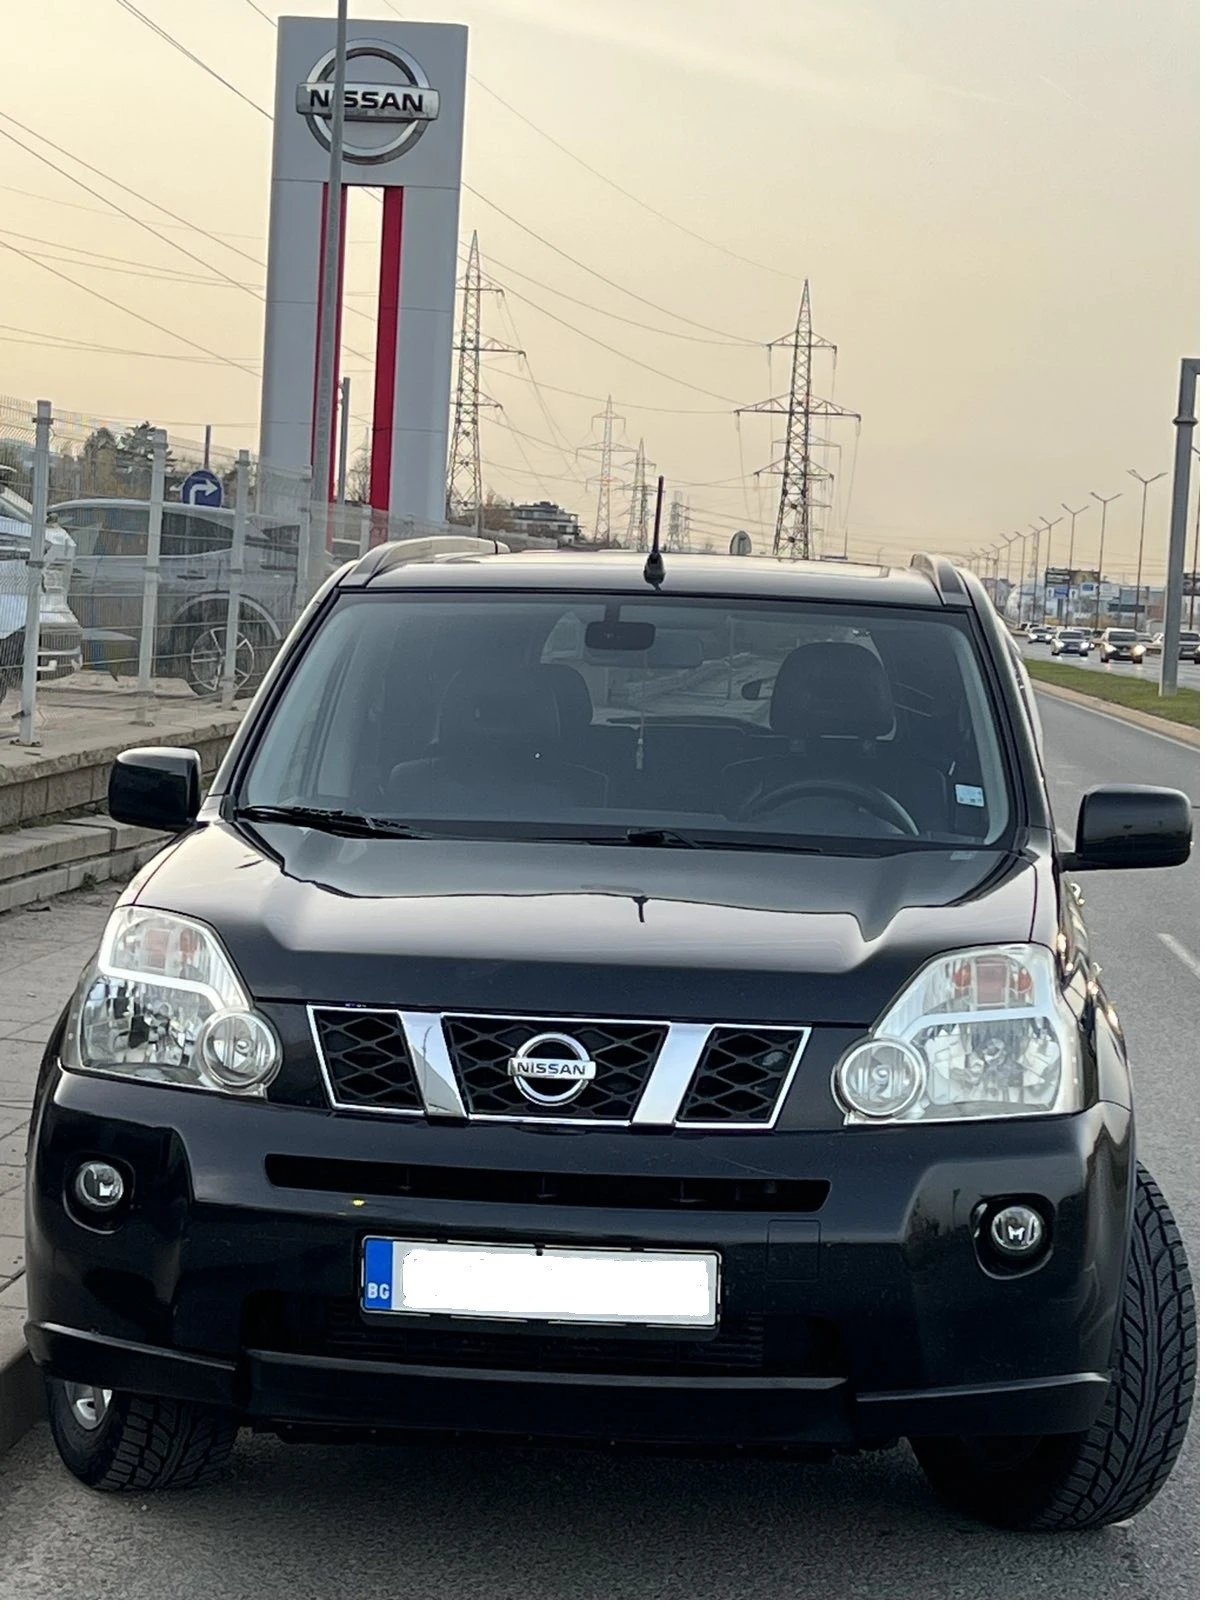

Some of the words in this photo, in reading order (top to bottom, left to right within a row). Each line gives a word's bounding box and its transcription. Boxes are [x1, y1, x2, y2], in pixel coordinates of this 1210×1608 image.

[310, 89, 423, 113] NSSAN
[517, 1062, 586, 1075] NISSAN
[368, 1282, 390, 1299] BG
